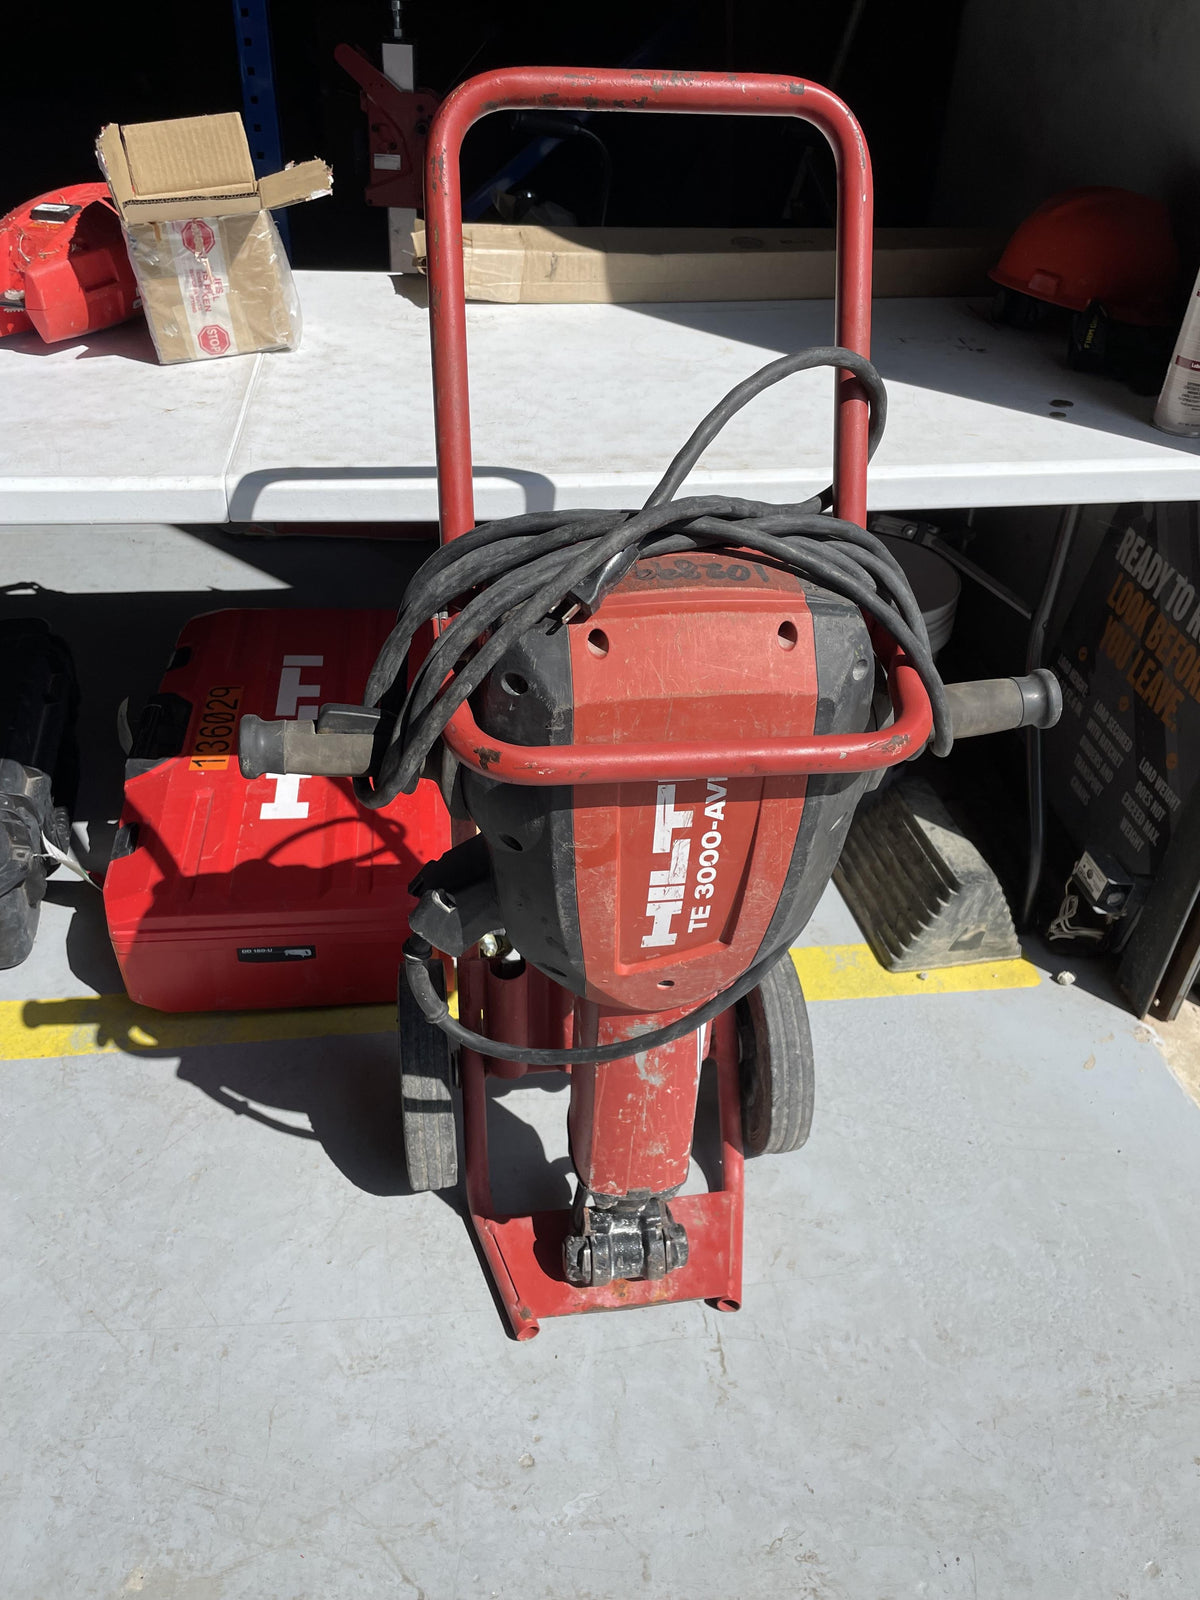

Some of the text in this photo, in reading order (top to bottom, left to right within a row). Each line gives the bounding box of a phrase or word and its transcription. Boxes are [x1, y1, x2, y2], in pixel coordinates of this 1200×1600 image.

[207, 327, 223, 353] STOP
[1115, 526, 1176, 600] READY
[1165, 573, 1195, 621] TO
[1107, 571, 1155, 638] LOOK
[1100, 615, 1136, 670] YOU
[192, 686, 242, 767] 136029
[1094, 699, 1110, 723] LOAD
[1121, 791, 1146, 827] EXCEED
[1135, 780, 1166, 822] DOES NOT
[1139, 756, 1181, 812] LOAD WEIGHT
[687, 777, 728, 933] TE 3000-AV
[1120, 815, 1145, 853] WEIGHT
[641, 778, 693, 948] HILT
